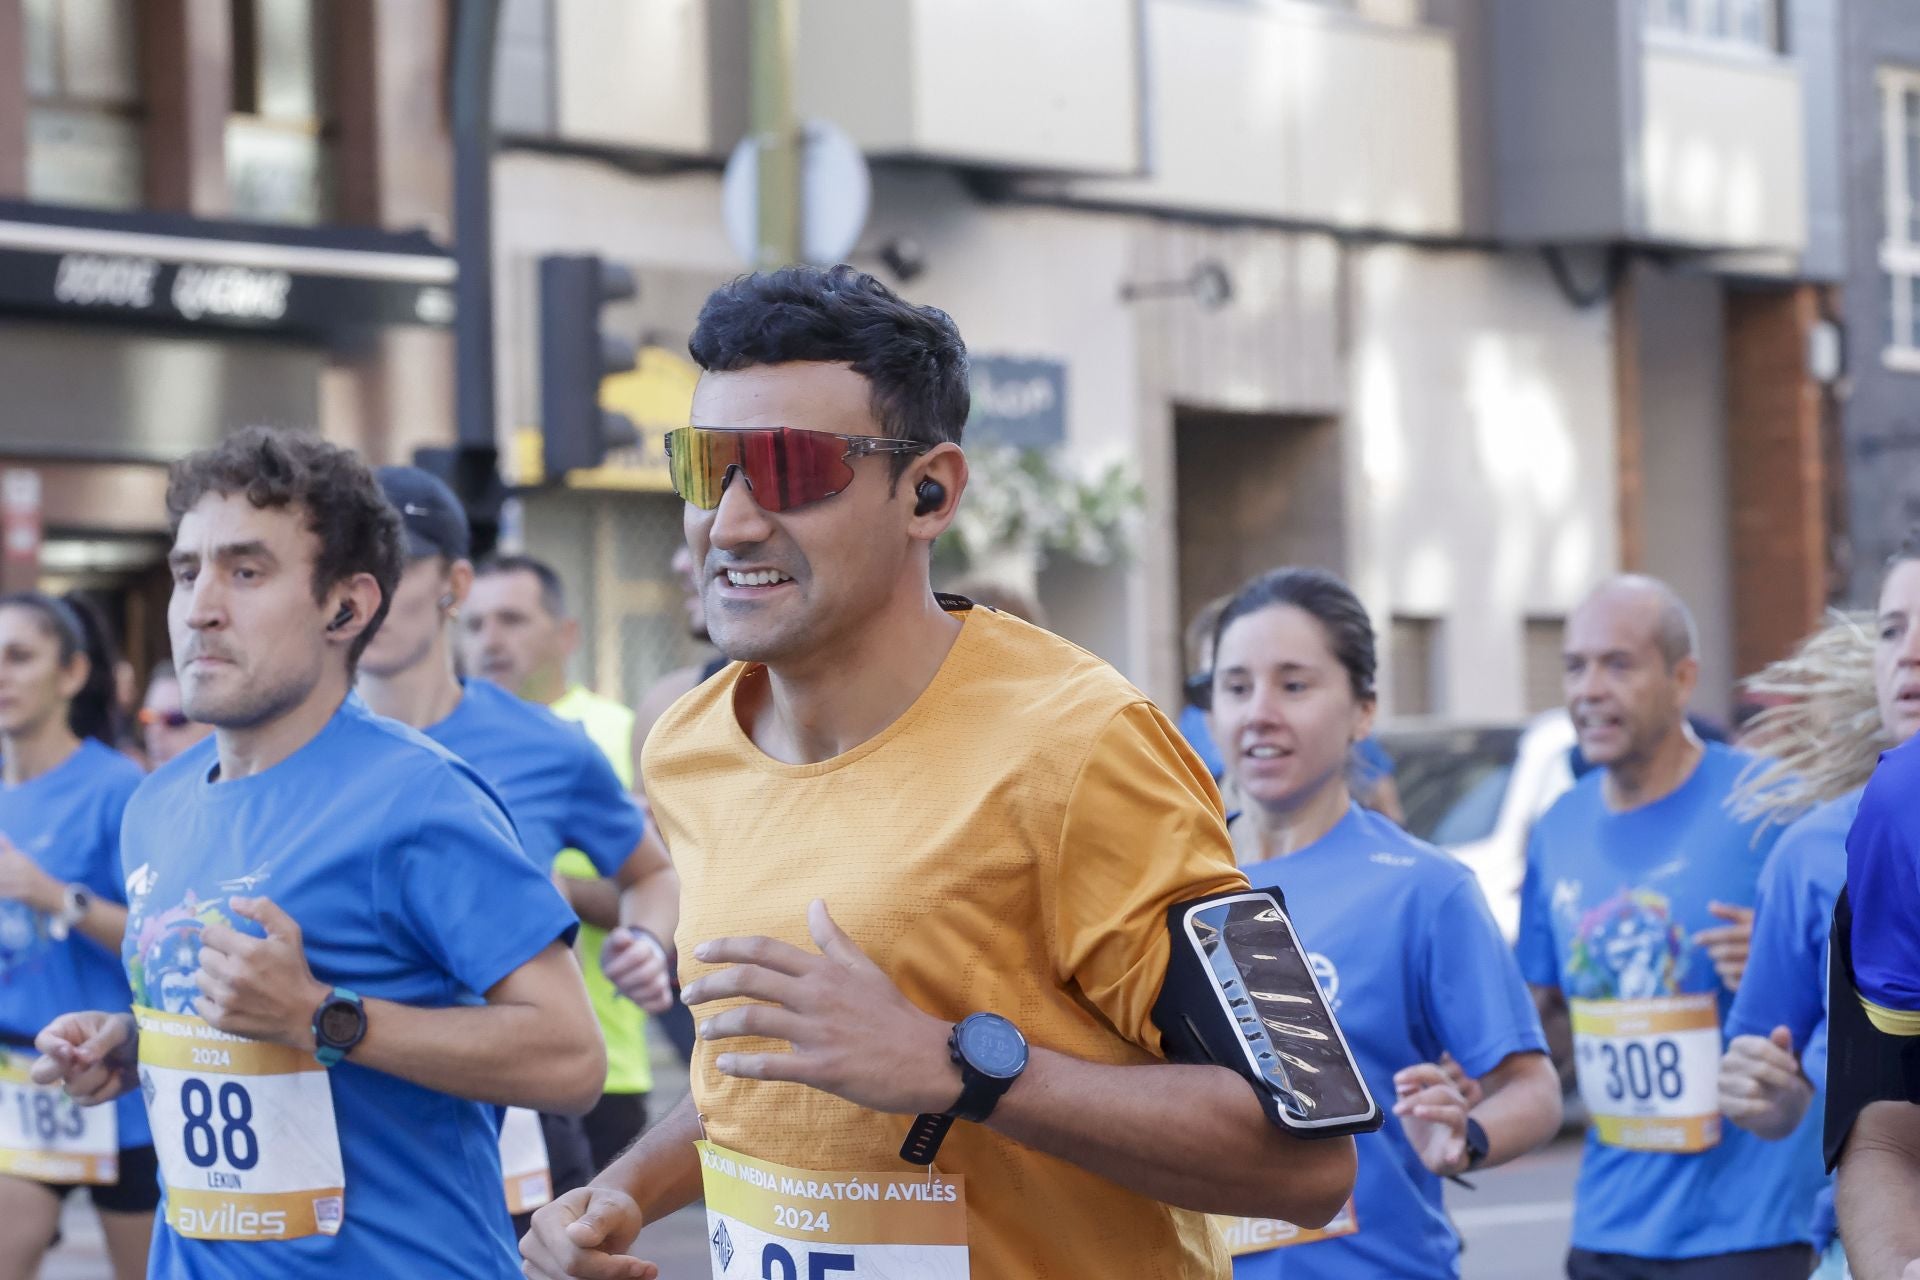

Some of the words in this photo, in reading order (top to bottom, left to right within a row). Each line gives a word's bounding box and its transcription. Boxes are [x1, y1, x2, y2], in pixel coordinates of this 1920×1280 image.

[195, 1025, 254, 1044] MARA
[192, 1048, 230, 1067] 2024
[1602, 1040, 1682, 1100] 308
[16, 1091, 84, 1142] 183
[181, 1078, 259, 1171] 88
[207, 1171, 242, 1189] LEKUN
[738, 1163, 778, 1193] MEDIA
[780, 1176, 880, 1201] MARATÓN
[884, 1178, 958, 1202] AVILÉS
[774, 1204, 830, 1233] 2024
